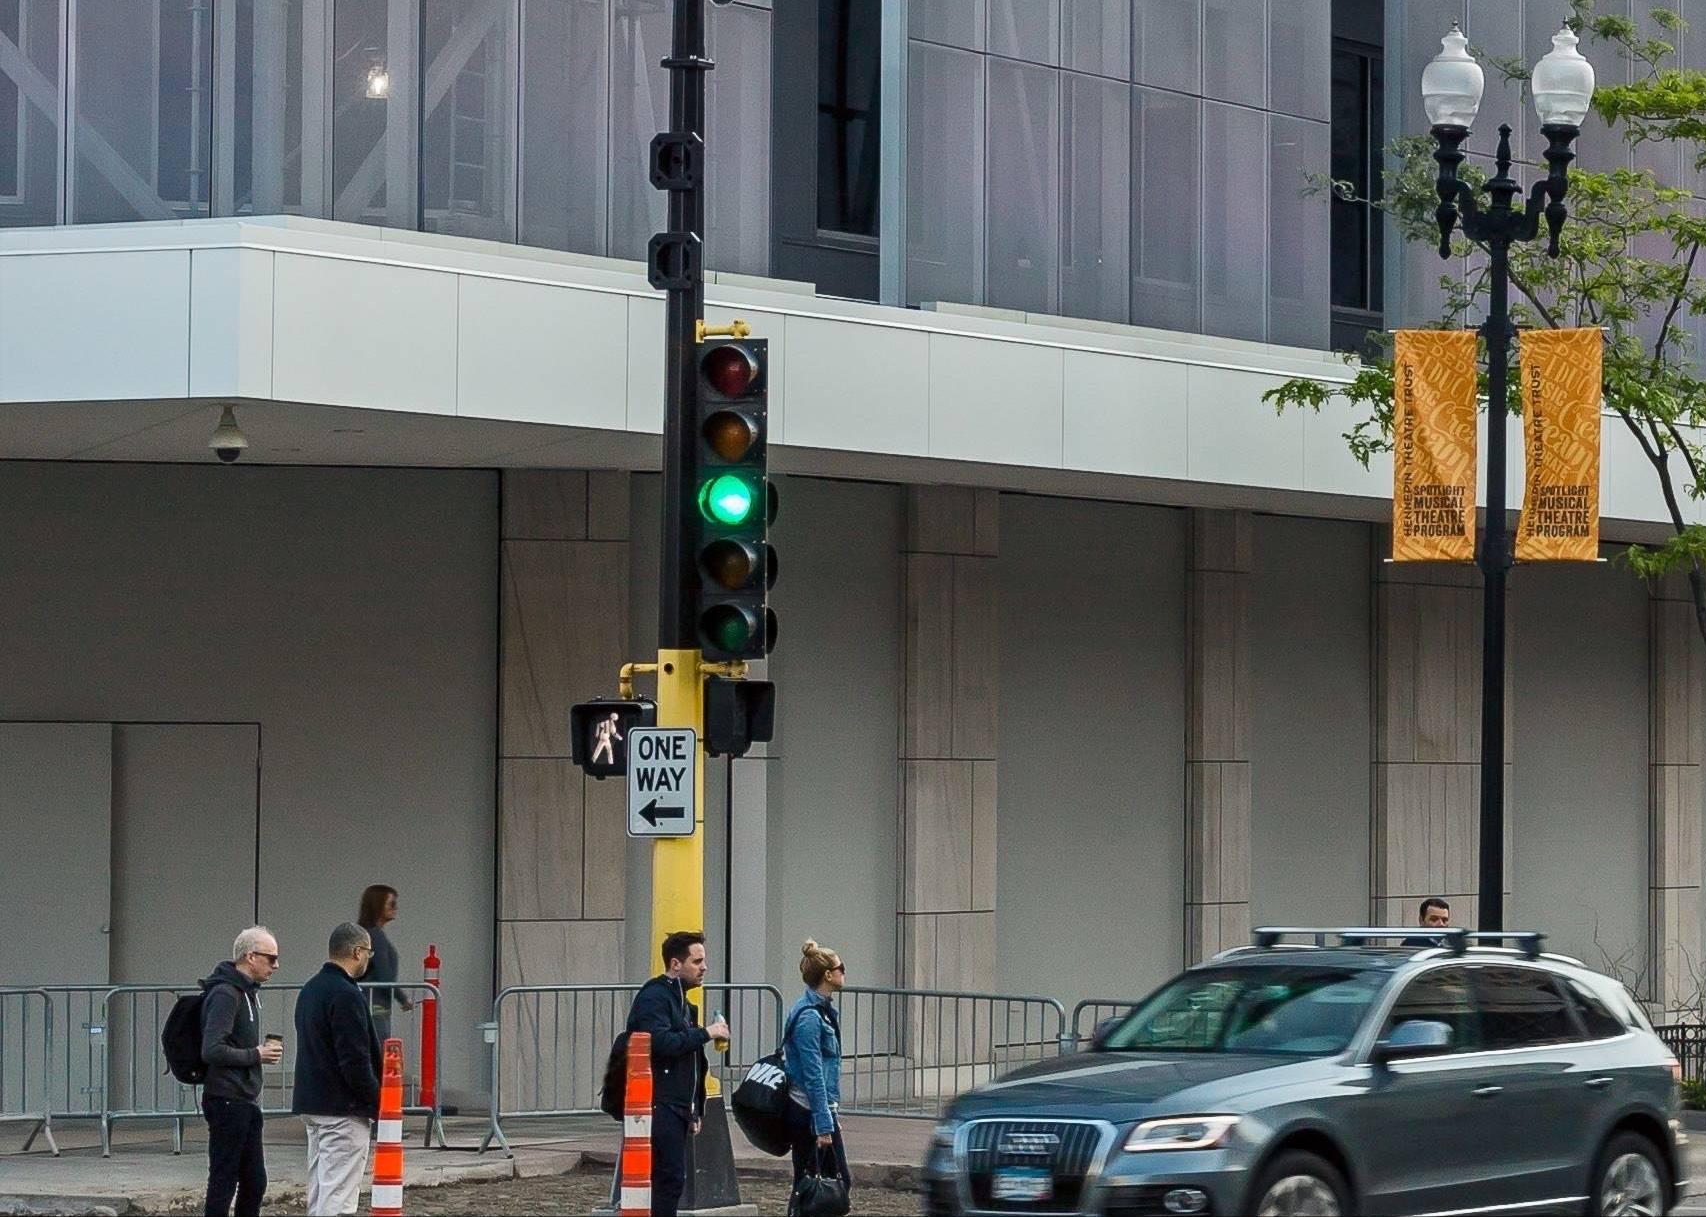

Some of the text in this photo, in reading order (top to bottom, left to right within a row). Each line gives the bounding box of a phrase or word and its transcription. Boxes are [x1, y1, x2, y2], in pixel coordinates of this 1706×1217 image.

[1531, 363, 1541, 403] TRUST
[1533, 411, 1544, 469] THEATRE
[1402, 361, 1414, 537] HENNEPIN THEATRE TRUST
[1413, 485, 1466, 496] SPOTLIGHT
[1540, 485, 1590, 496] SPOTLIGHT
[1413, 496, 1463, 509] MUSICAL
[1538, 497, 1590, 510] MUSICAL
[1413, 510, 1465, 523] THEATRE
[1536, 511, 1590, 524] THEATRE
[1413, 524, 1466, 537] PROGRAM
[1536, 524, 1590, 537] PROGRAM
[638, 736, 687, 761] ONE
[636, 766, 687, 792] WAY
[744, 1062, 786, 1091] NIKE
